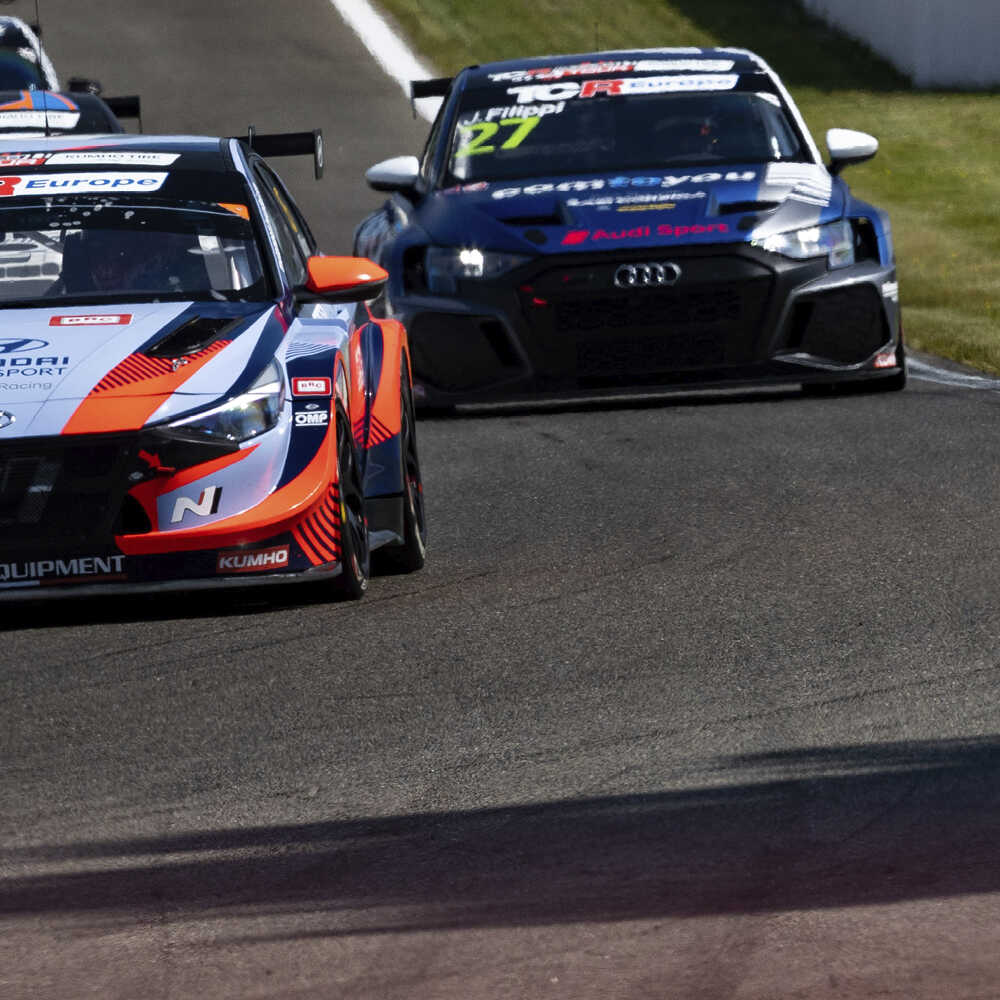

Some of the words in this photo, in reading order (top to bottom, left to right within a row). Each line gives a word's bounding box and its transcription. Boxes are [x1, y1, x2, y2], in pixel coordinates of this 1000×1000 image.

[507, 79, 625, 104] TCR
[453, 116, 541, 158] 27
[25, 176, 159, 189] Europe
[592, 227, 650, 240] Audi
[657, 223, 730, 236] Sport
[295, 412, 328, 425] OMP
[219, 549, 288, 569] KUMHO
